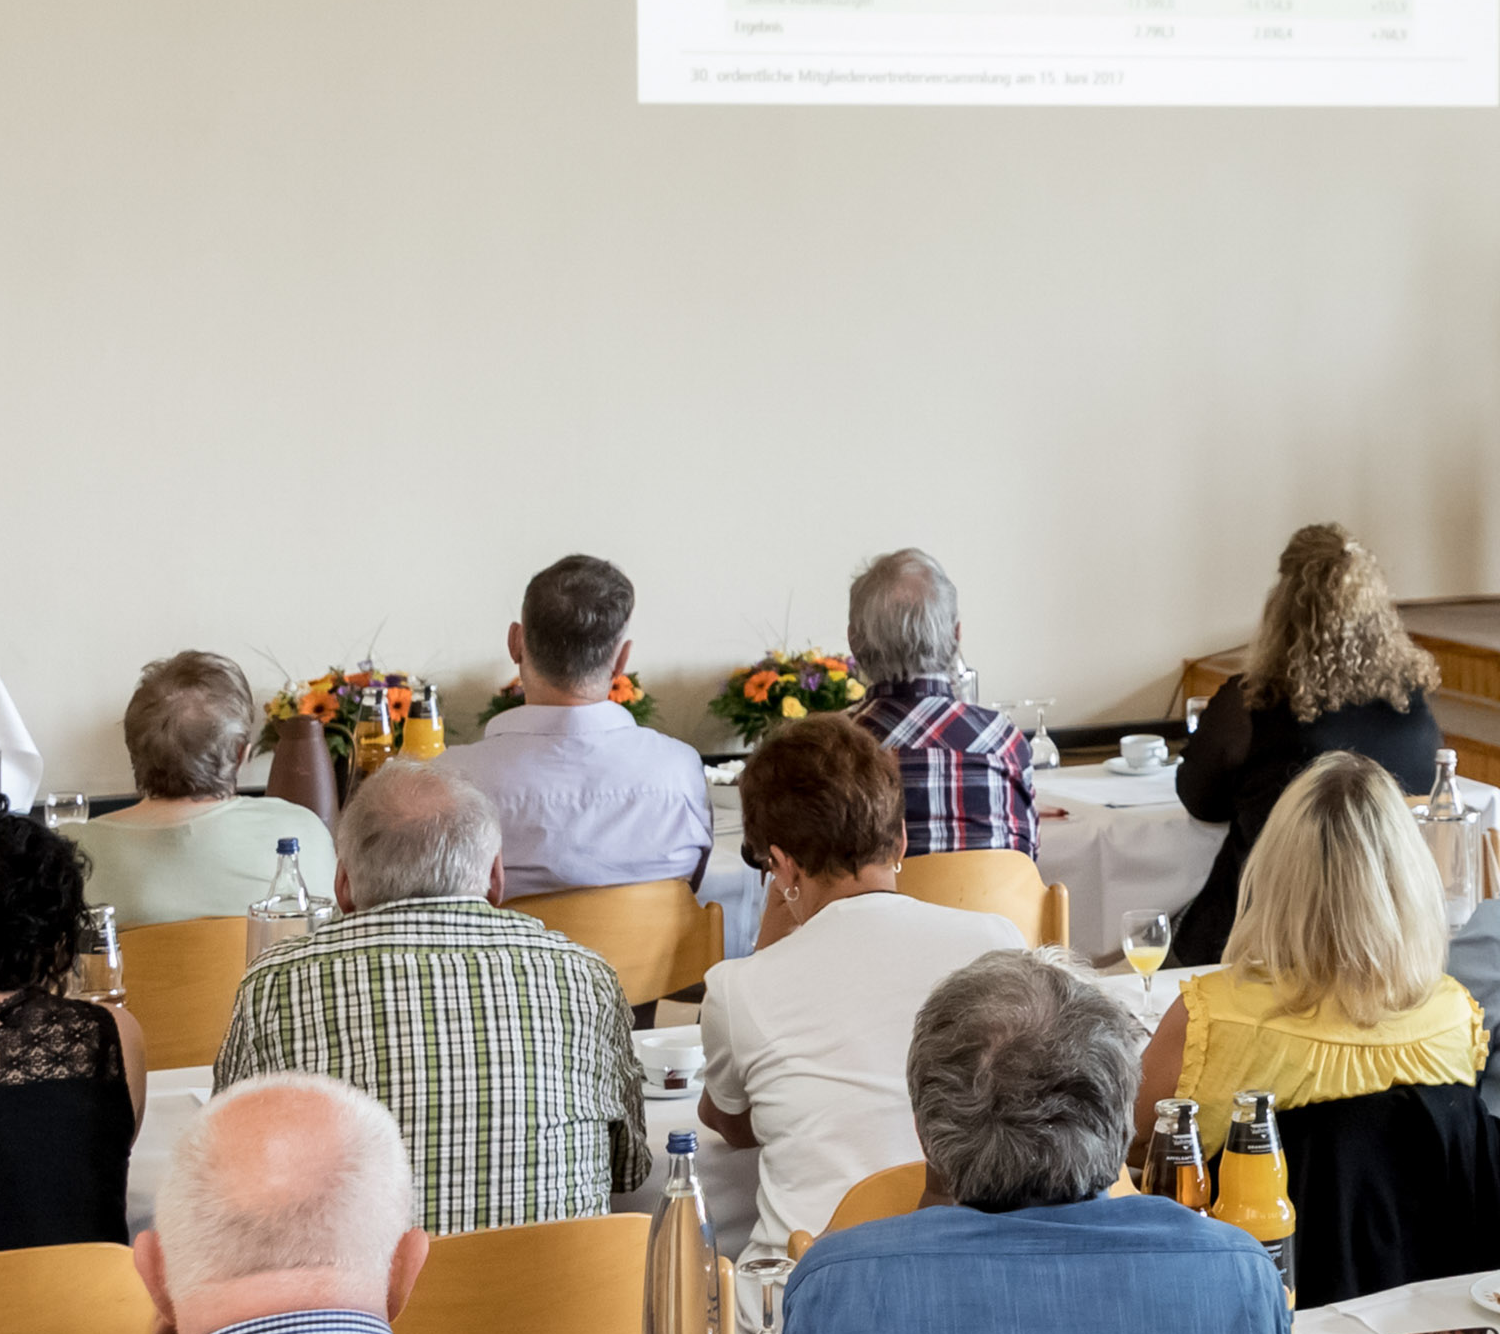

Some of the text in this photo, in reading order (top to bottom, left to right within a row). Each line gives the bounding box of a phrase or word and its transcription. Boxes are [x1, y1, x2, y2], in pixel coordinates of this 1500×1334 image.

[734, 20, 784, 36] Ergebnis
[716, 69, 794, 82] ordentliche
[1015, 74, 1035, 84] am
[1093, 71, 1125, 85] 2017
